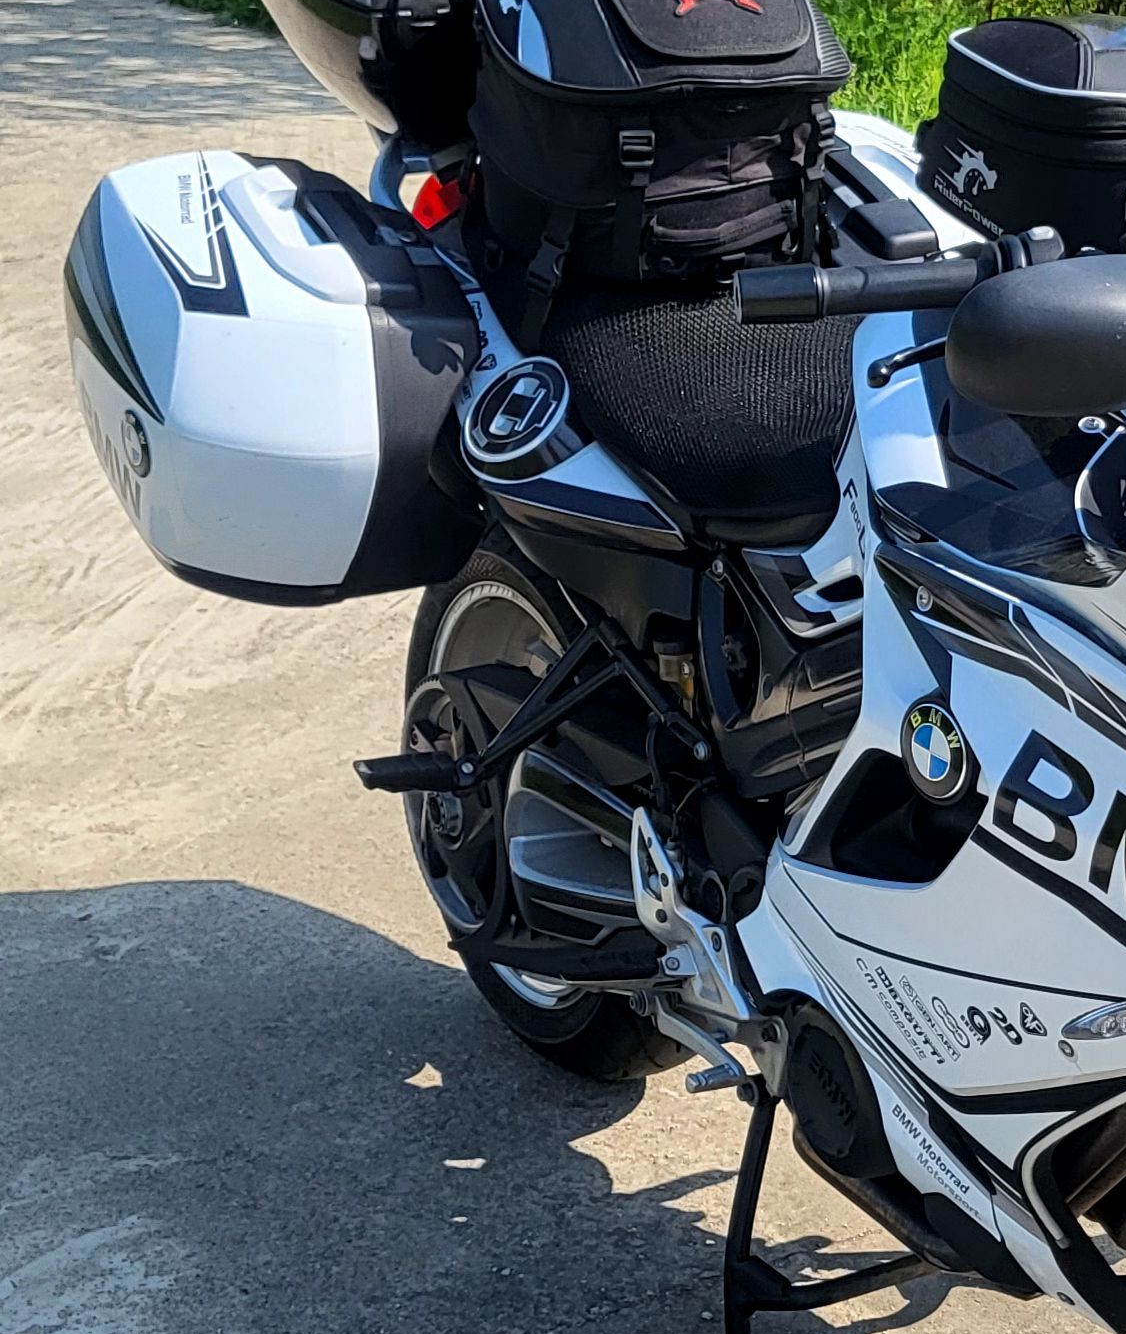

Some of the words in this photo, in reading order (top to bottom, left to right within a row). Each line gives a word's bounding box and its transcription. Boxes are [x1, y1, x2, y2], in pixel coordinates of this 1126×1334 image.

[934, 174, 1004, 236] RiderPower
[910, 708, 961, 749] BMW
[888, 987, 946, 1065] BAGUTTI
[914, 997, 960, 1058] GEN-ART
[891, 1104, 921, 1139] BMW
[919, 1138, 970, 1195] Motorrad
[916, 1153, 980, 1217] Motorsport
